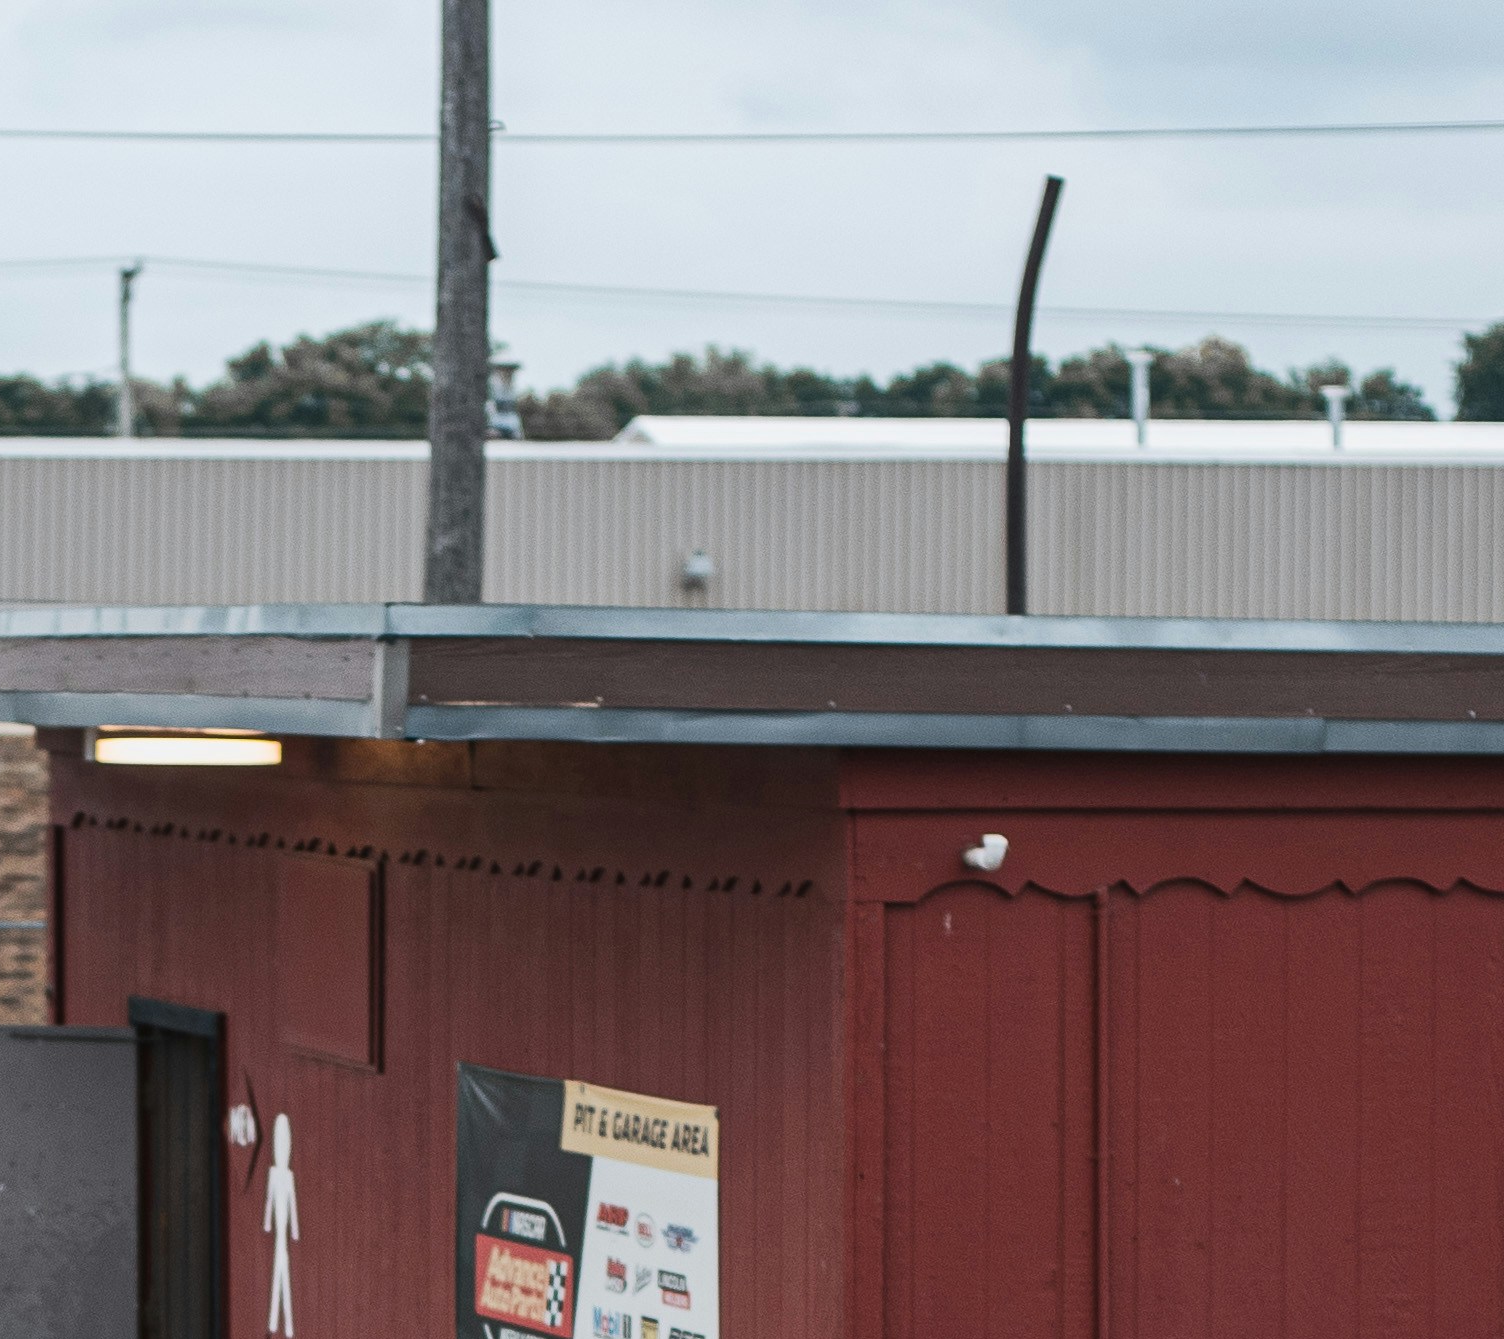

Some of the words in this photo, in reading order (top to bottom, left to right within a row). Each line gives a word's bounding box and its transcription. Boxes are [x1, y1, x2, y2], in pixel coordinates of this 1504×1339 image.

[574, 1103, 596, 1134] PIT
[598, 1107, 608, 1138] &
[613, 1110, 669, 1150] GARAGE
[671, 1120, 710, 1157] AREA
[488, 1245, 547, 1292] Advance
[593, 1305, 621, 1336] Mobil
